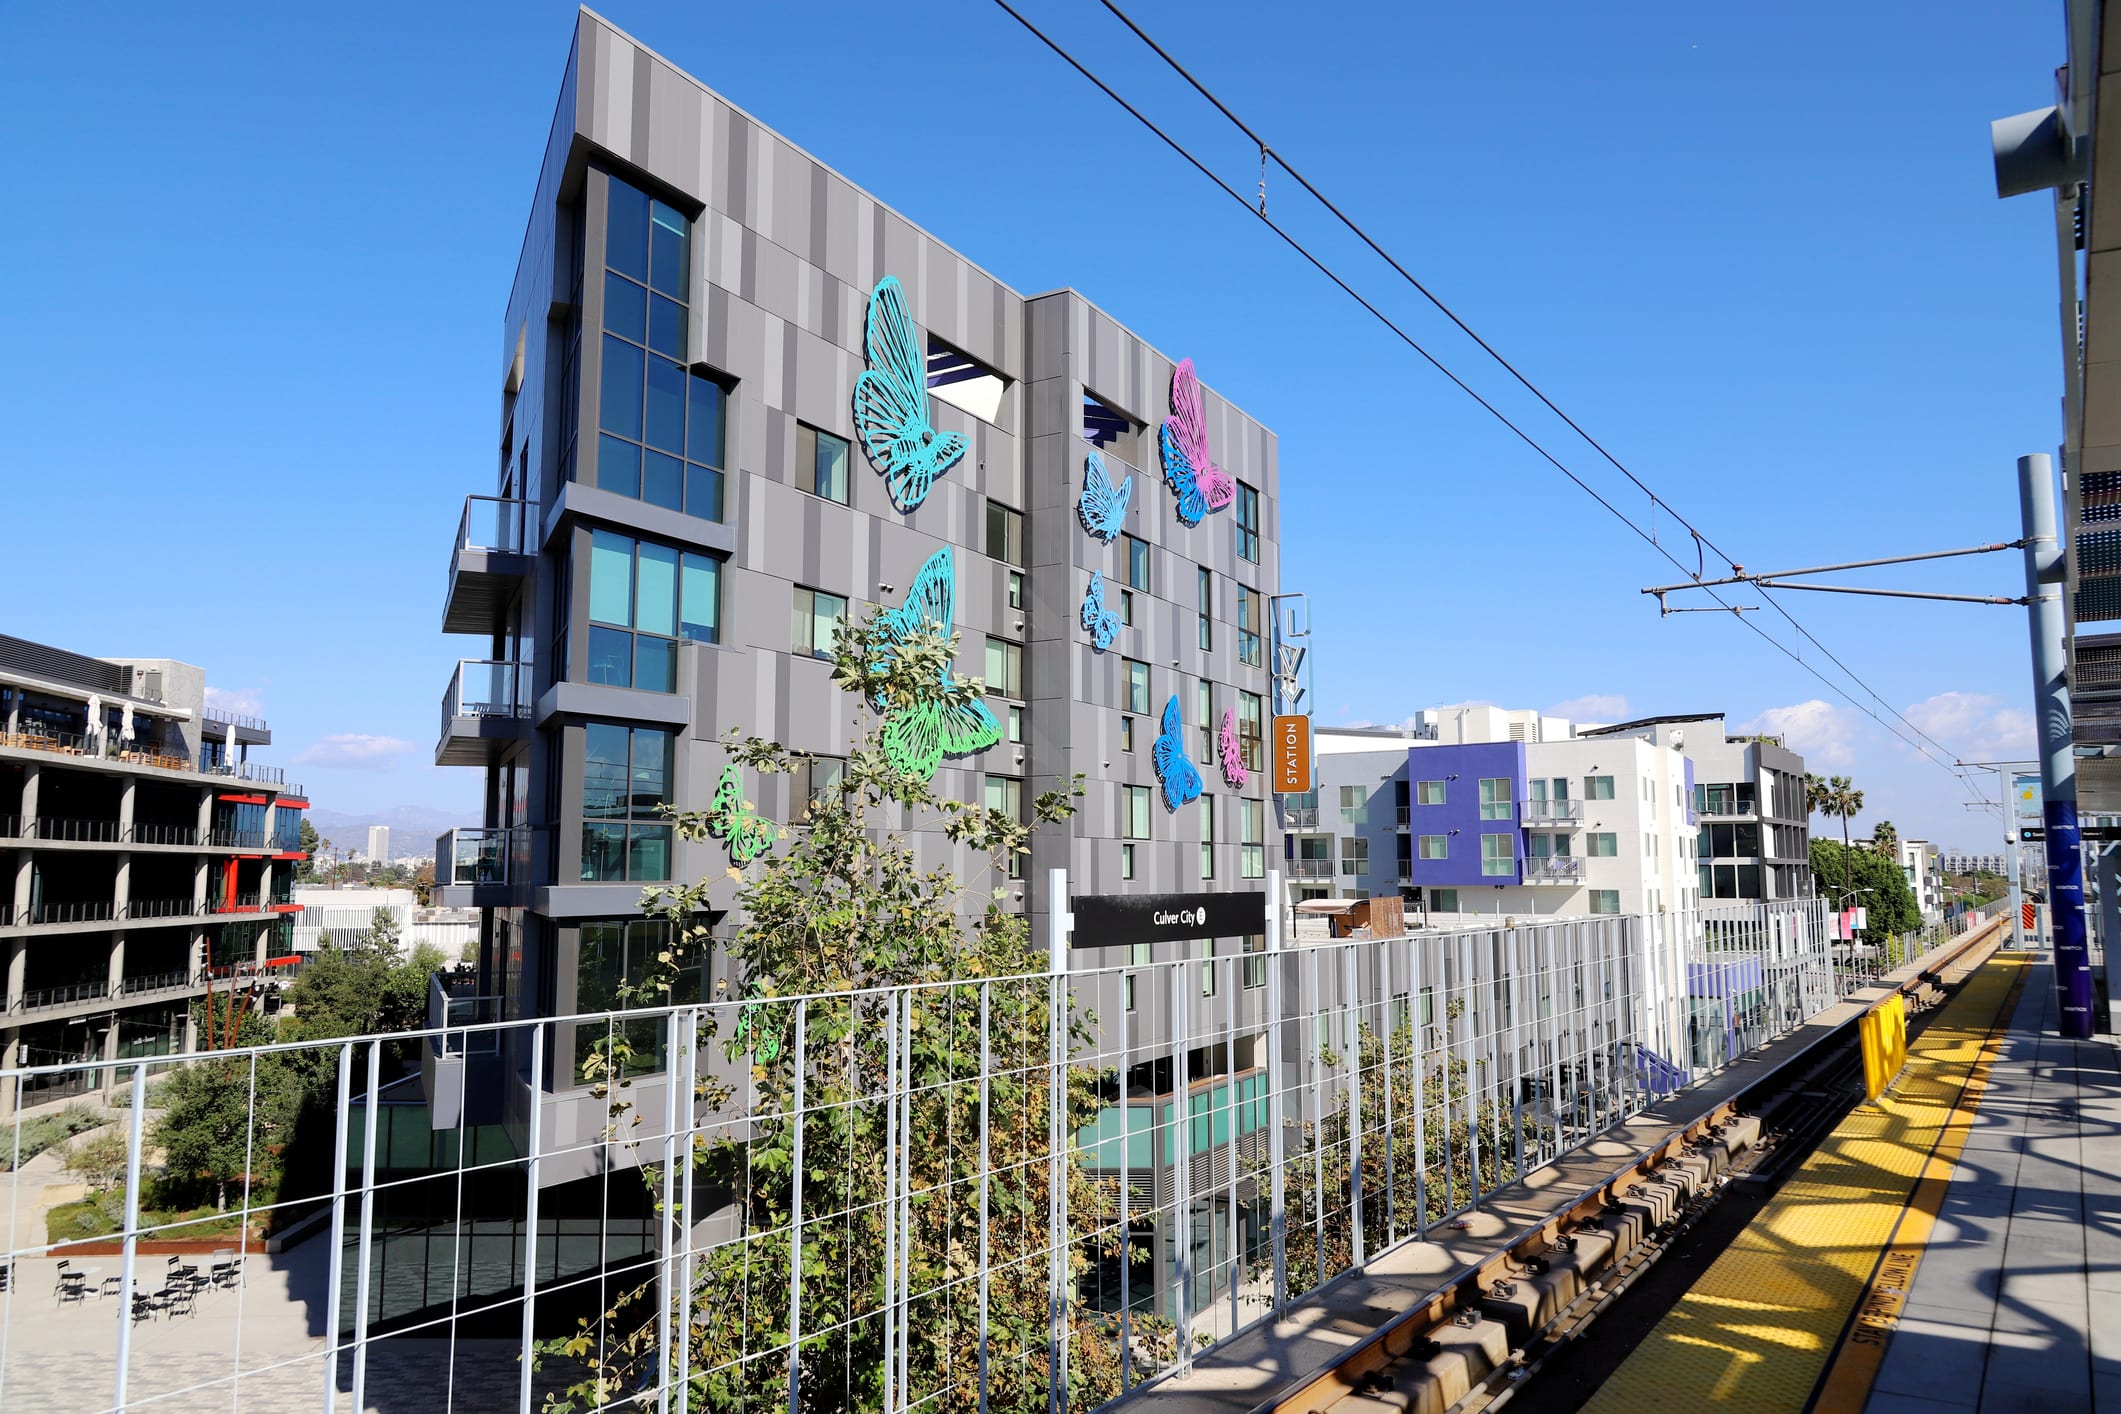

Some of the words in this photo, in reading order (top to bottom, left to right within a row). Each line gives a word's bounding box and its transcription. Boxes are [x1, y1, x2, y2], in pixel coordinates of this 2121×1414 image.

[1286, 723, 1297, 785] STATION
[1153, 910, 1179, 925] Culver
[1180, 909, 1195, 927] City
[1886, 1253, 1914, 1268] LINE
[1873, 1267, 1908, 1296] YELLOW
[1861, 1295, 1897, 1323] BEHIND
[1852, 1323, 1884, 1345] STAY
